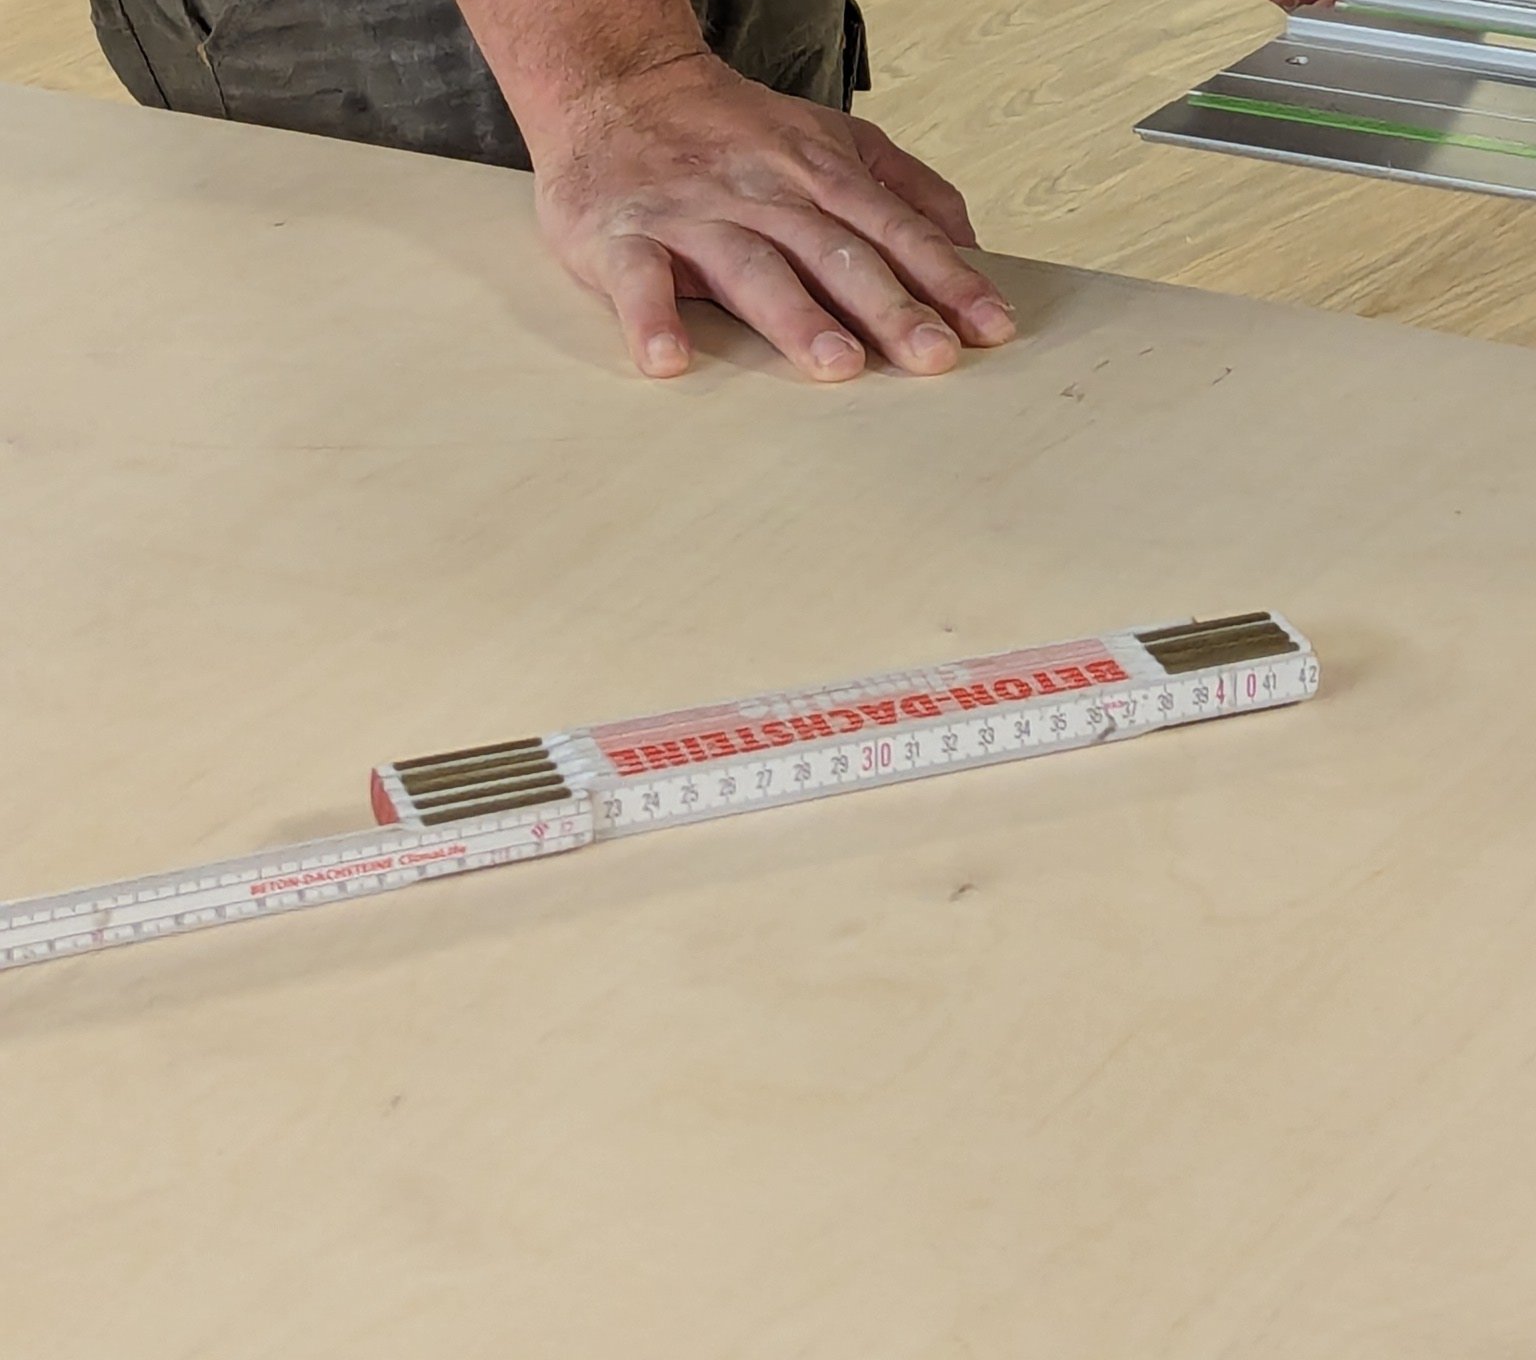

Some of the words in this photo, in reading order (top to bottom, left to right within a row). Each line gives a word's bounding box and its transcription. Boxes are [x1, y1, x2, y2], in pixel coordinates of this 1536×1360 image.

[603, 799, 622, 819] 23
[642, 791, 660, 812] 24
[680, 783, 699, 805] 25
[755, 769, 774, 790] 27
[793, 761, 812, 782] 28
[830, 755, 849, 775] 29
[861, 742, 892, 771] 30
[904, 738, 921, 760] 31
[941, 732, 959, 754] 32
[977, 726, 996, 749] 33
[1013, 720, 1032, 740] 34
[1050, 713, 1068, 733] 35
[1122, 699, 1138, 719] 37
[1262, 669, 1280, 690] 41
[1297, 664, 1318, 686] 42
[607, 659, 1131, 775] BETON-DACHSTEINE
